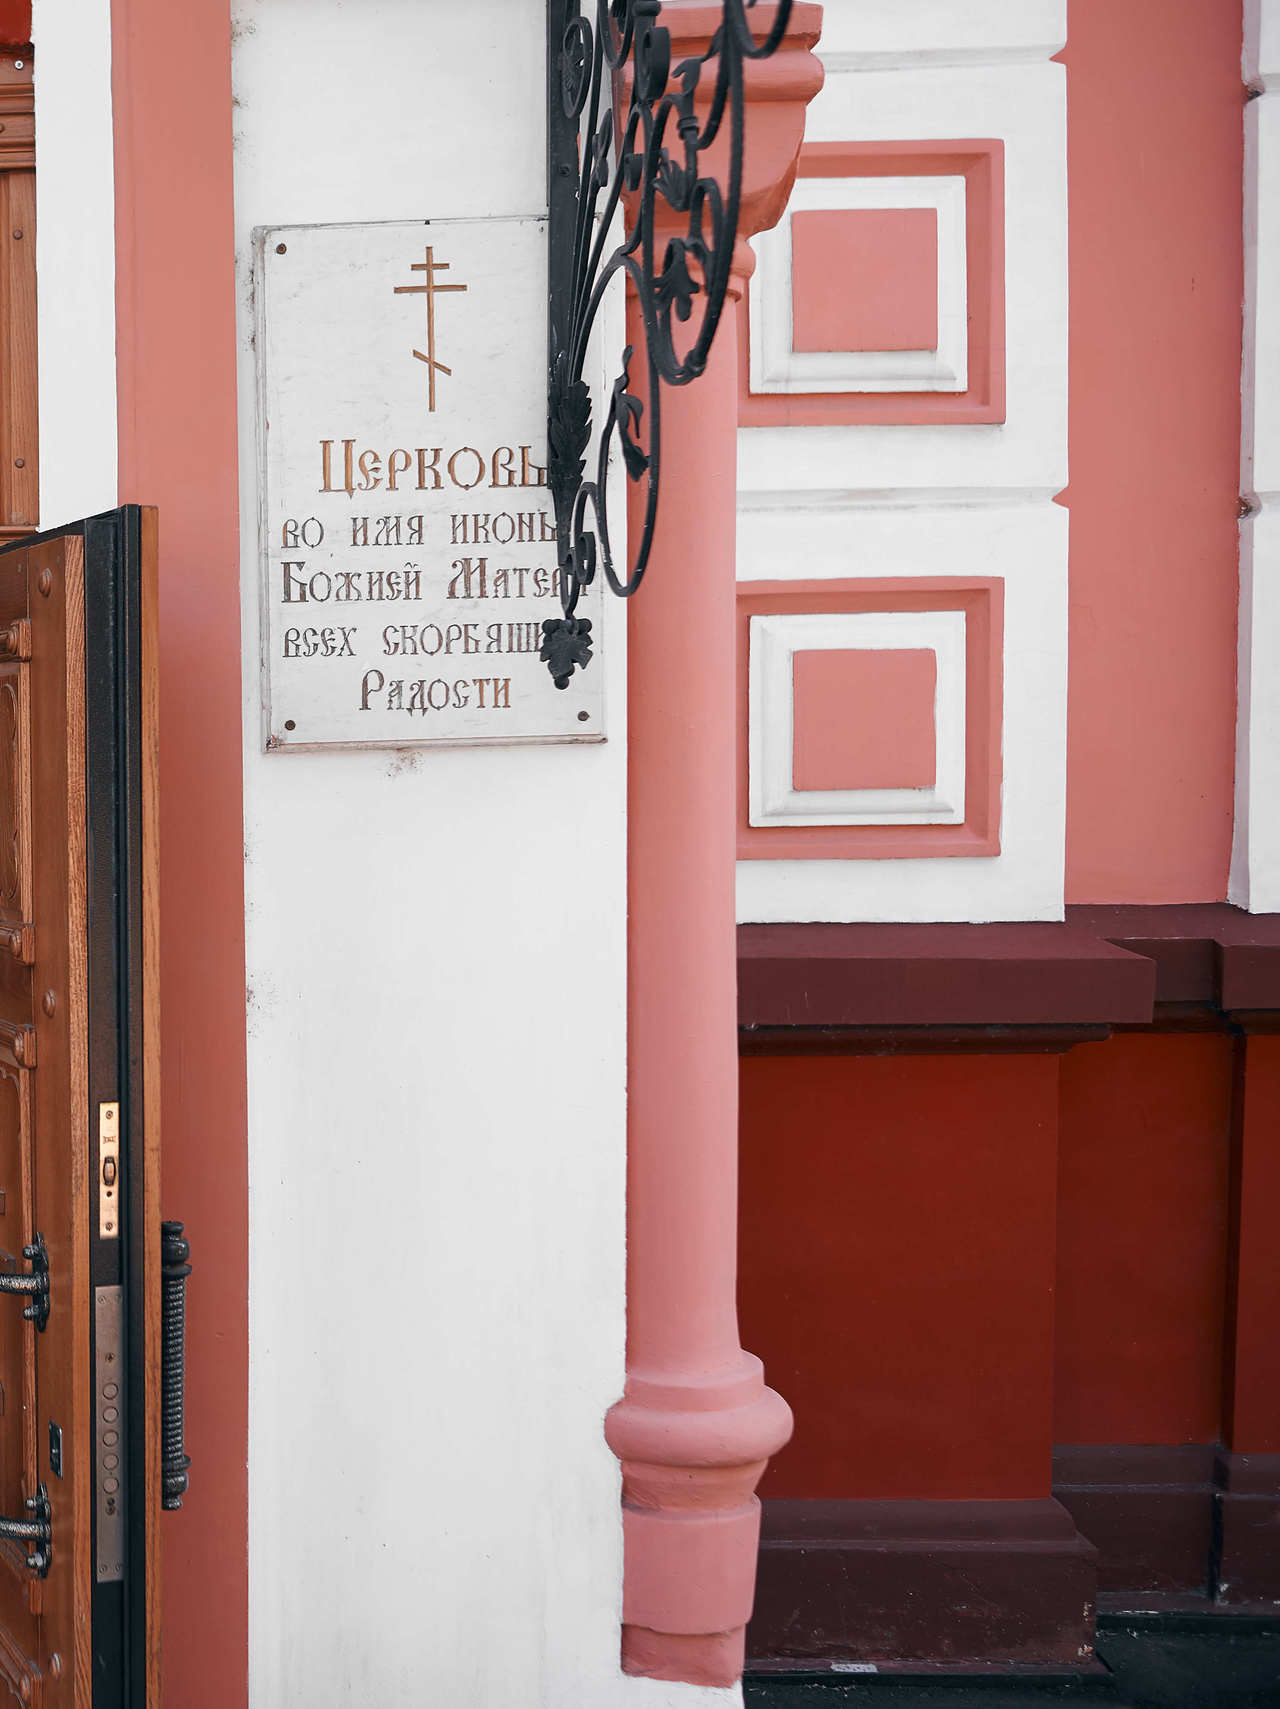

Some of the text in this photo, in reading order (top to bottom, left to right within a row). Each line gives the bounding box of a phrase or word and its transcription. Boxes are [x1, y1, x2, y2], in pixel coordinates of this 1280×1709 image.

[317, 438, 548, 499] Церковь
[280, 516, 325, 549] во
[349, 514, 425, 547] имя
[280, 557, 589, 604] Божией Матер
[282, 626, 358, 658] всех
[358, 669, 512, 718] Радости
